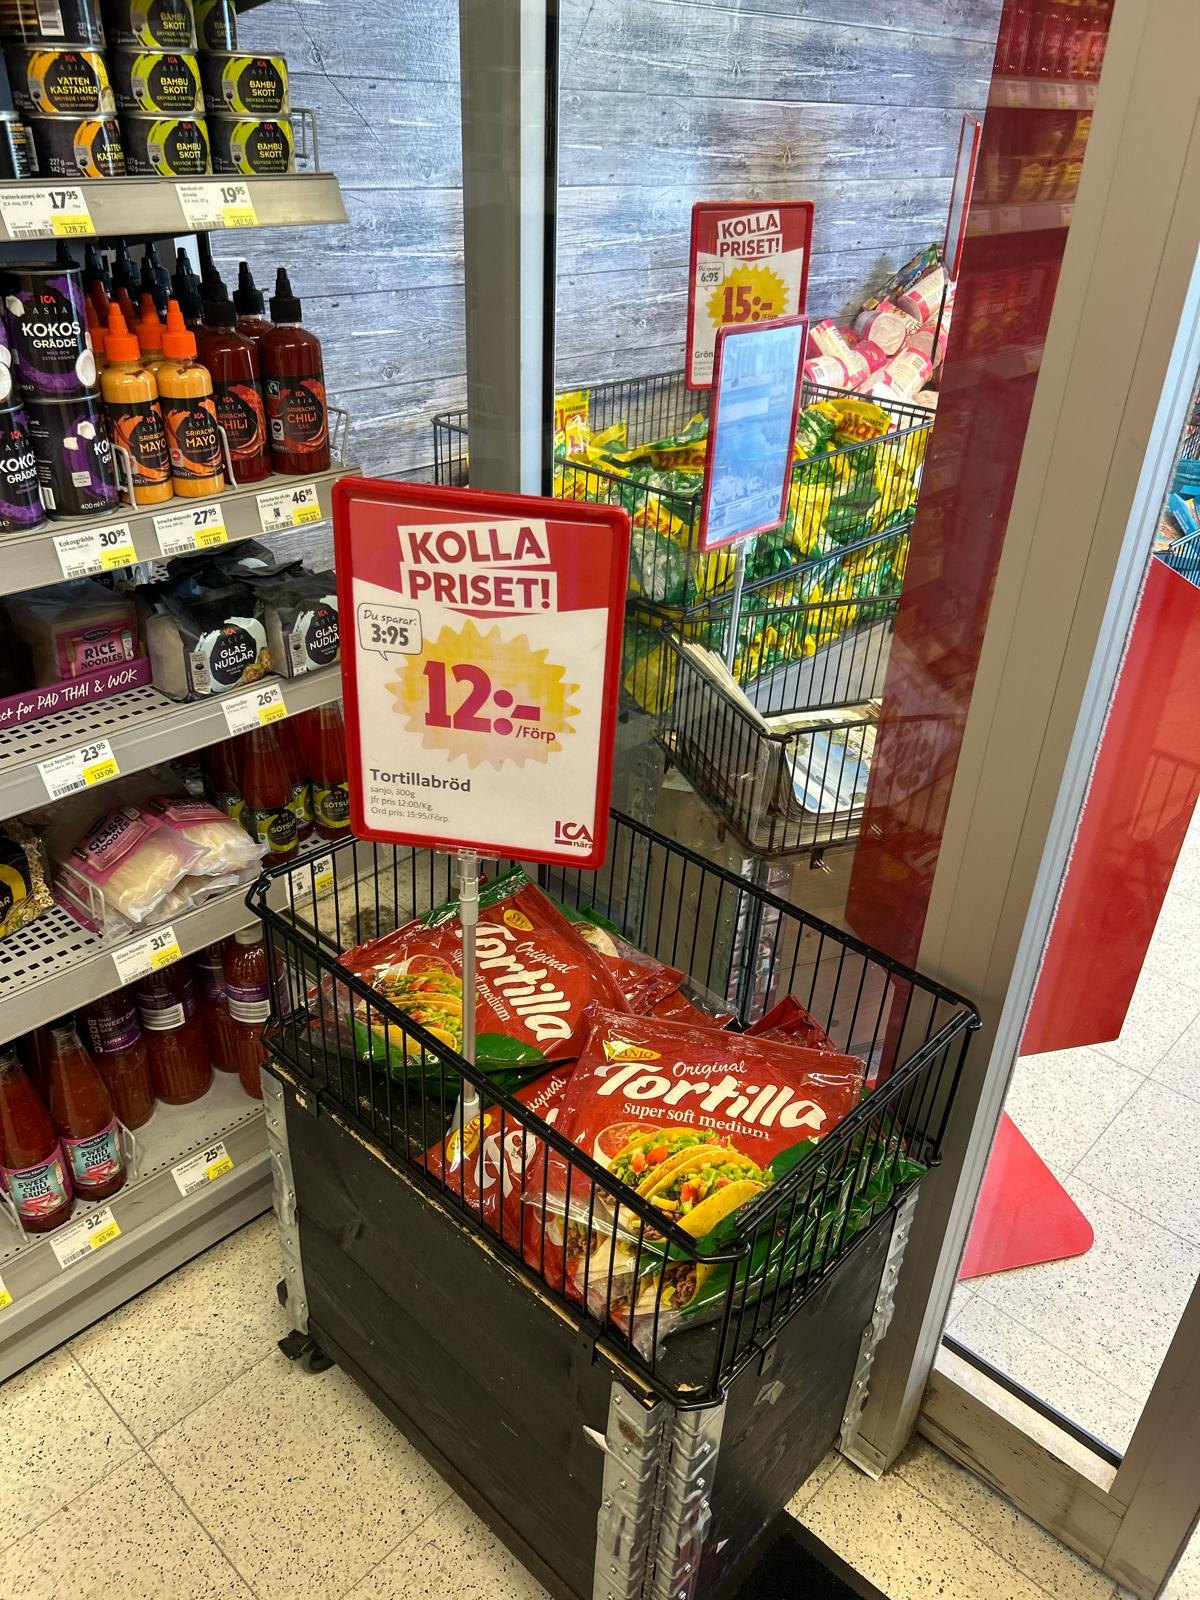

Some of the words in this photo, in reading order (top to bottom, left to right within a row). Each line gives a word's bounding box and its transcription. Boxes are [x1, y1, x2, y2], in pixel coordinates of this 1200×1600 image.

[160, 12, 186, 21] BAMBU
[163, 22, 186, 30] SKOTT
[57, 77, 90, 85] VATTEN
[160, 78, 188, 86] BAMBU
[250, 80, 276, 88] BAMBU
[50, 86, 98, 94] KASTANJER
[163, 86, 188, 94] SKOTT
[722, 214, 778, 239] KOLLA
[720, 238, 780, 257] PRISET!
[700, 272, 719, 282] 6:95
[40, 295, 56, 304] ICA
[722, 286, 772, 323] 15:-
[32, 306, 68, 315] ASIA
[22, 322, 81, 337] KOKOS
[33, 338, 78, 349] GRÄDDE
[287, 412, 317, 423] CHILI
[10, 431, 22, 439] ICA
[186, 435, 216, 447] MAYO
[140, 438, 166, 453] MAYO
[407, 526, 546, 565] KOLLA
[408, 569, 551, 610] PRISET!
[364, 610, 378, 620] Du
[381, 615, 417, 626] sparar:
[316, 624, 338, 638] GLAS
[371, 623, 409, 646] 3:95
[310, 633, 339, 650] NUDLA
[85, 641, 116, 659] RICE
[220, 644, 246, 658] GLAS
[81, 653, 122, 670] NOODLES
[214, 650, 254, 670] NUDLAR
[0, 708, 13, 720] ct
[16, 702, 34, 720] for
[38, 694, 58, 709] PAD
[61, 682, 89, 701] THAI
[94, 680, 105, 693] &
[108, 669, 138, 689] WOK
[422, 660, 540, 736] 12:-
[516, 724, 556, 744] /Förp
[94, 768, 114, 780] 133:06
[370, 768, 471, 792] Tortillabröd
[382, 797, 396, 806] pris
[371, 806, 387, 815] Ord
[389, 809, 405, 817] pris:
[88, 816, 125, 852] GLASS
[94, 820, 130, 856] NOODLES
[555, 821, 593, 843] ICA
[515, 941, 578, 974] Original
[455, 922, 574, 1042] Tortilla
[477, 984, 511, 1022] medium
[99, 1017, 124, 1028] SWEET
[672, 1060, 747, 1079] Original
[594, 1062, 828, 1130] Tortilla
[623, 1103, 665, 1119] Super
[666, 1107, 695, 1124] soft
[699, 1116, 769, 1140] medium
[81, 1141, 109, 1158] SWEET
[86, 1149, 108, 1162] CHILI
[85, 1153, 112, 1168] SAUCE
[18, 1174, 48, 1188] SWEET
[24, 1182, 47, 1192] CHILI
[22, 1186, 51, 1199] SAUCE
[99, 1231, 115, 1242] 65:90
